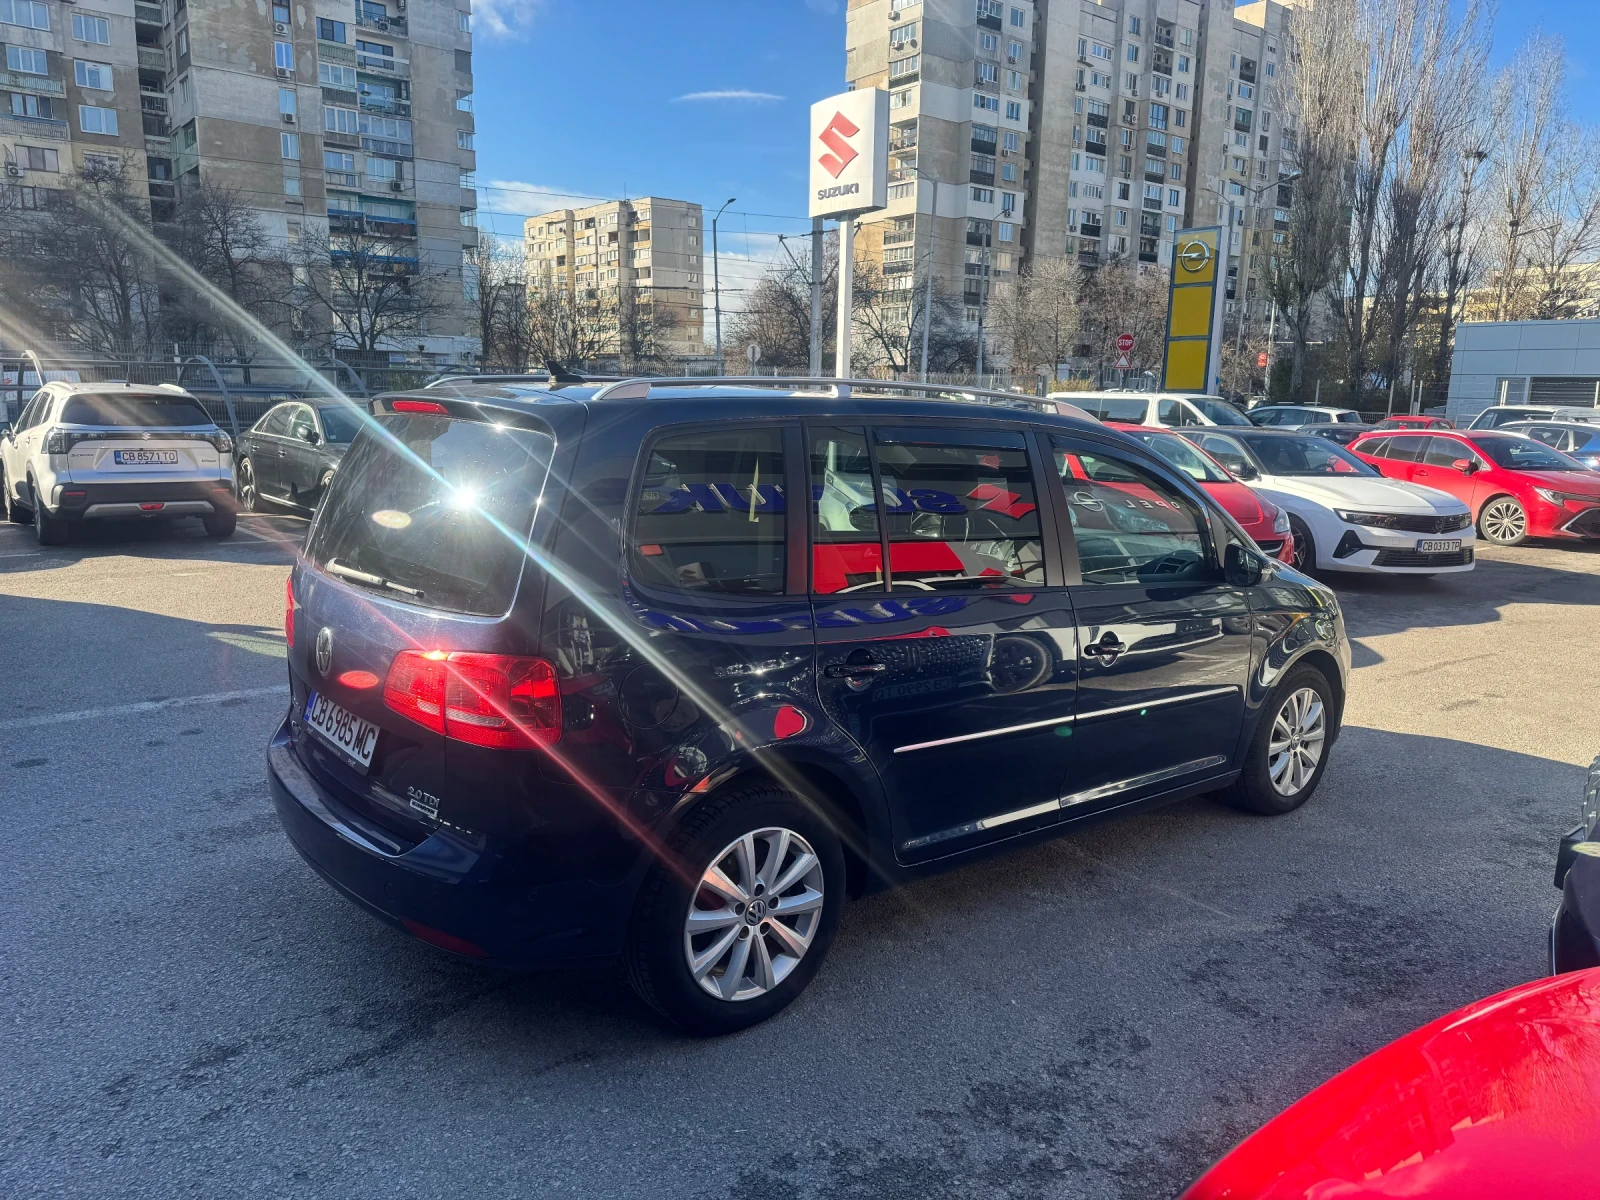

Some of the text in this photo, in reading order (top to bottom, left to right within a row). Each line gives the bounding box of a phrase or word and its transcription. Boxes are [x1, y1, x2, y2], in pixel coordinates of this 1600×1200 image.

[817, 182, 860, 201] SUZUKI
[122, 452, 136, 461] CB
[137, 452, 160, 461] 8571
[162, 452, 175, 461] TO
[1422, 541, 1460, 551] CB 0313 TP
[311, 693, 329, 727] CB
[326, 704, 358, 747] 6985
[352, 720, 376, 760] MC
[407, 785, 423, 800] 2.0
[423, 792, 441, 809] TDI
